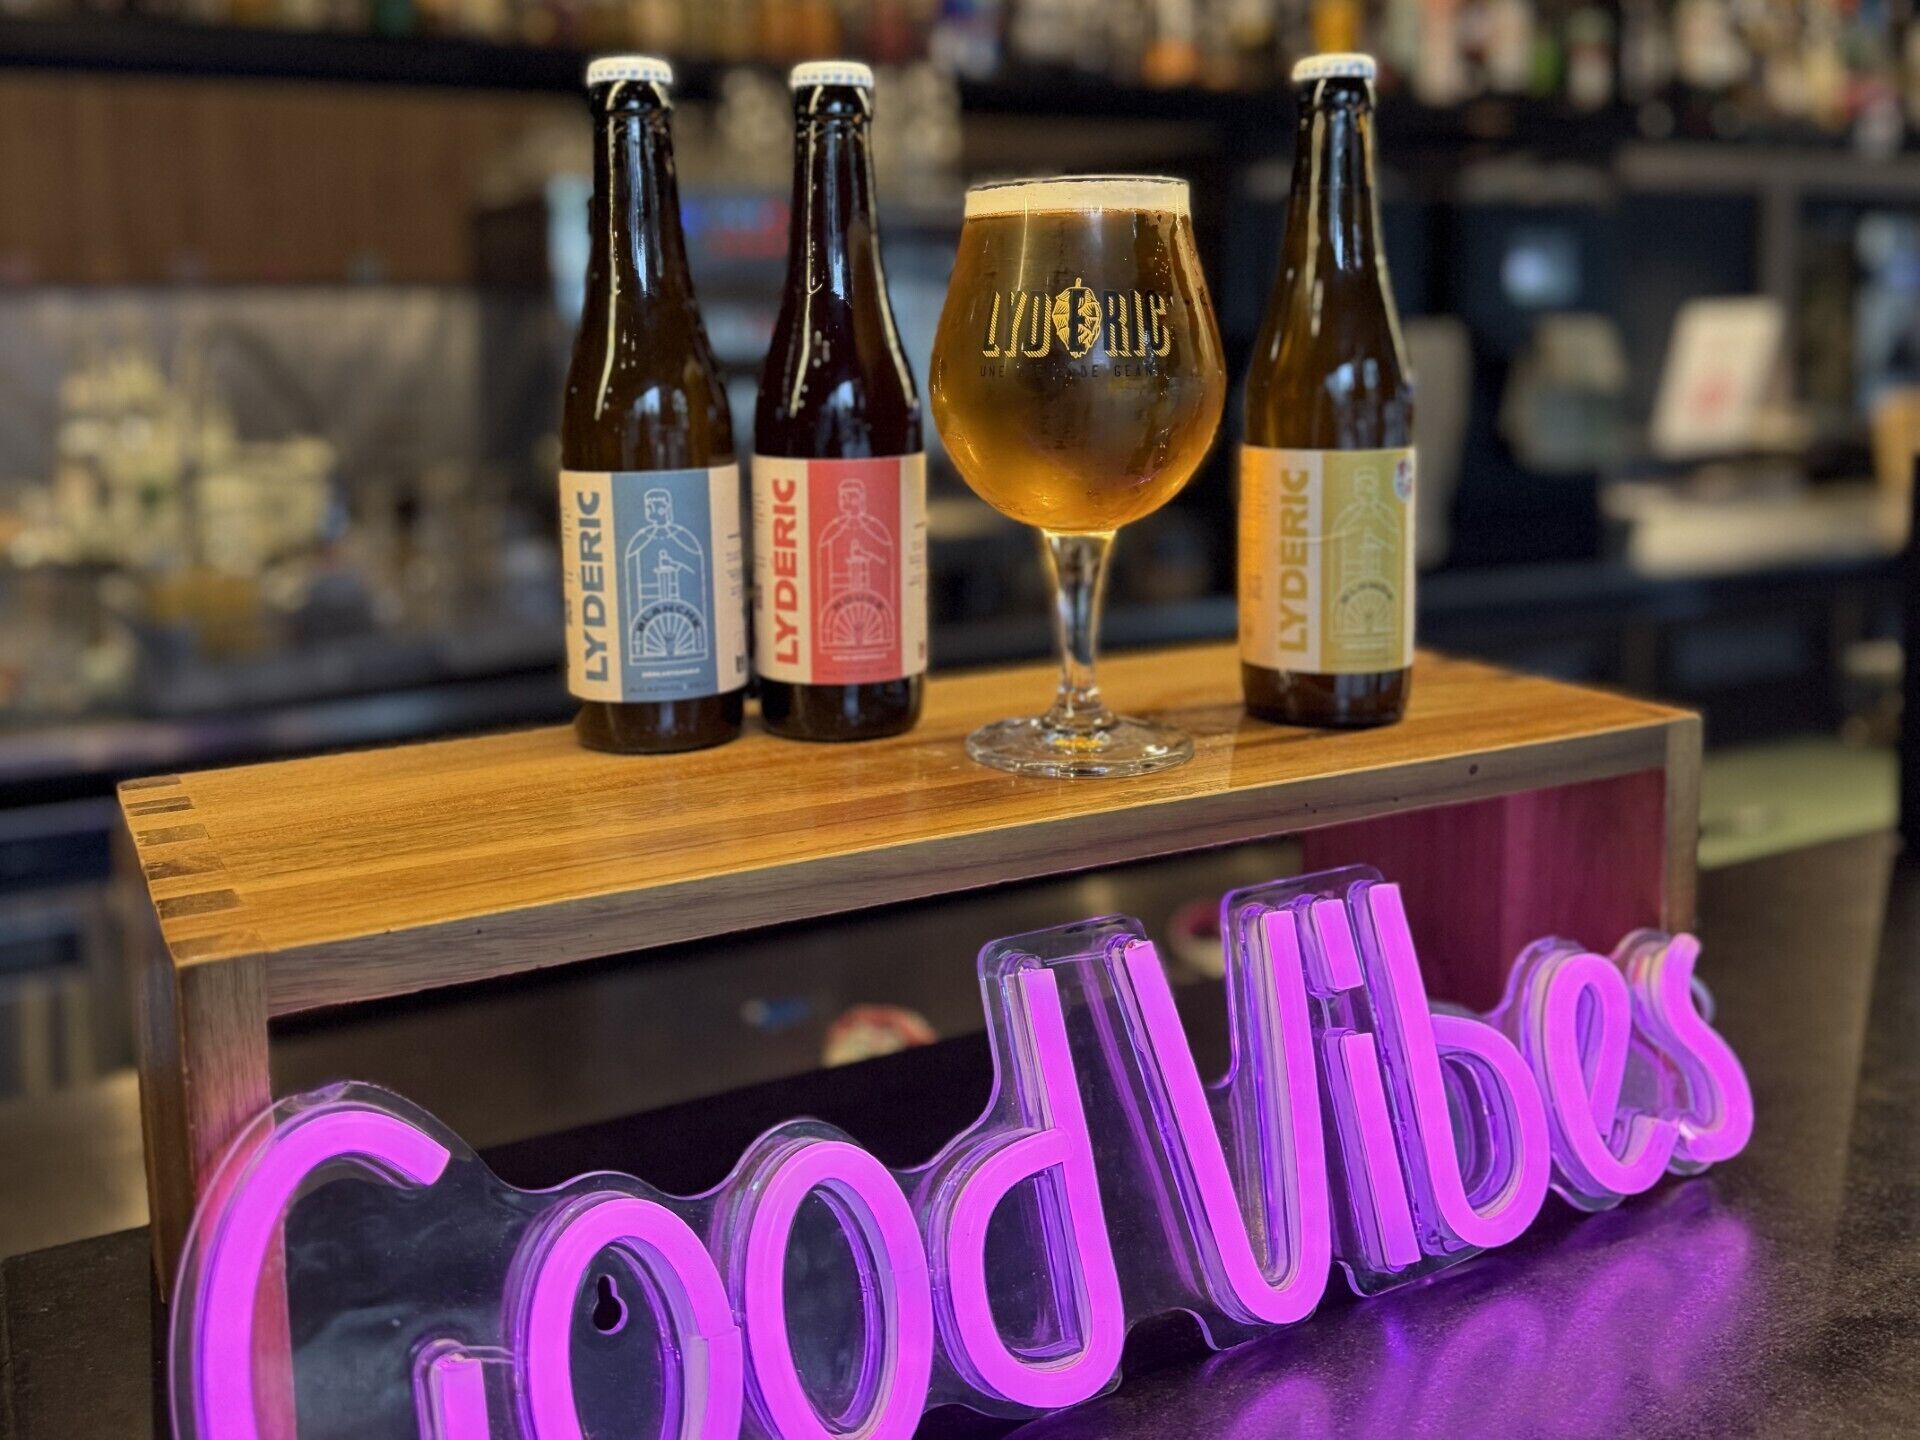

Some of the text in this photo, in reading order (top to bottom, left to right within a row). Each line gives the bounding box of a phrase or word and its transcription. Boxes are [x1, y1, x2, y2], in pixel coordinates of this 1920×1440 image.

[982, 287, 1171, 358] LYDERIC
[577, 490, 609, 682] LYDERIC
[772, 479, 799, 665] LYDERIC
[1279, 468, 1309, 654] LYDERIC
[1108, 882, 1754, 1325] Vibes
